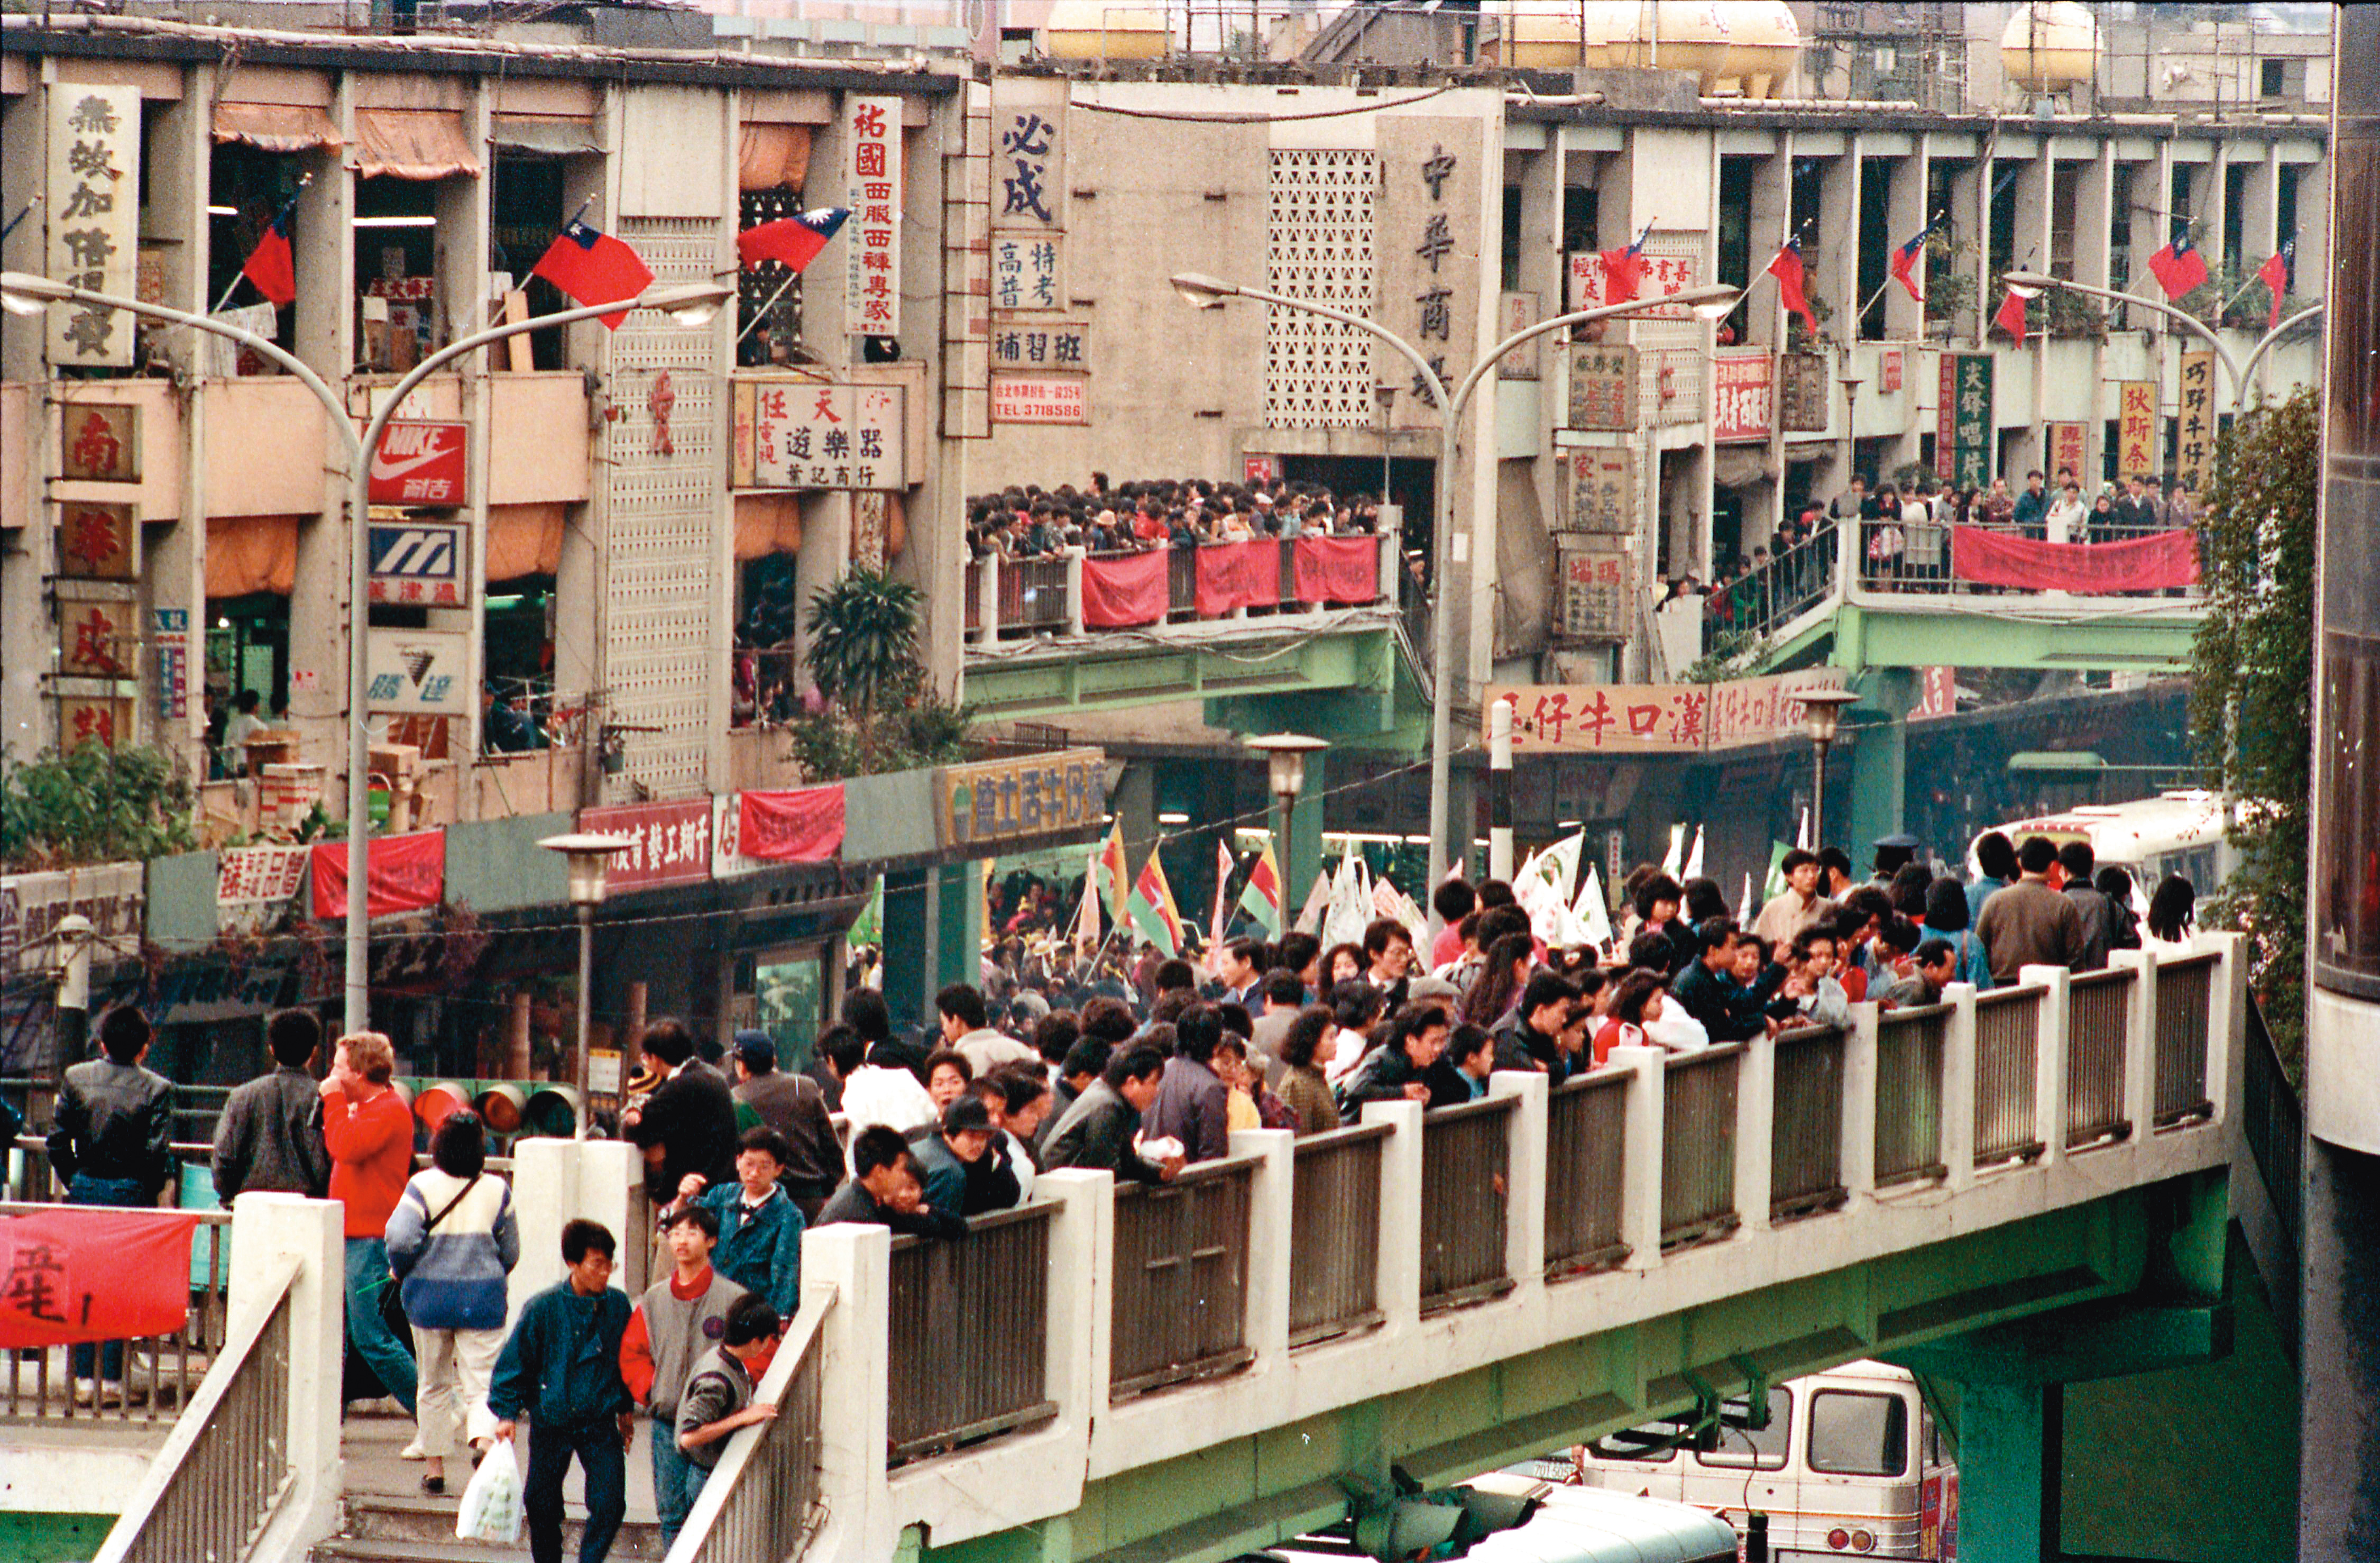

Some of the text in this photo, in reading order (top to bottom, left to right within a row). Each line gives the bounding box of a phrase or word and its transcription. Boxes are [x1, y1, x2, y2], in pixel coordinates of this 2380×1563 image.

[1002, 112, 1054, 222] 必成
[1411, 143, 1457, 409] 中華商場
[995, 331, 1081, 362] 補習班
[383, 426, 443, 455] NIKE
